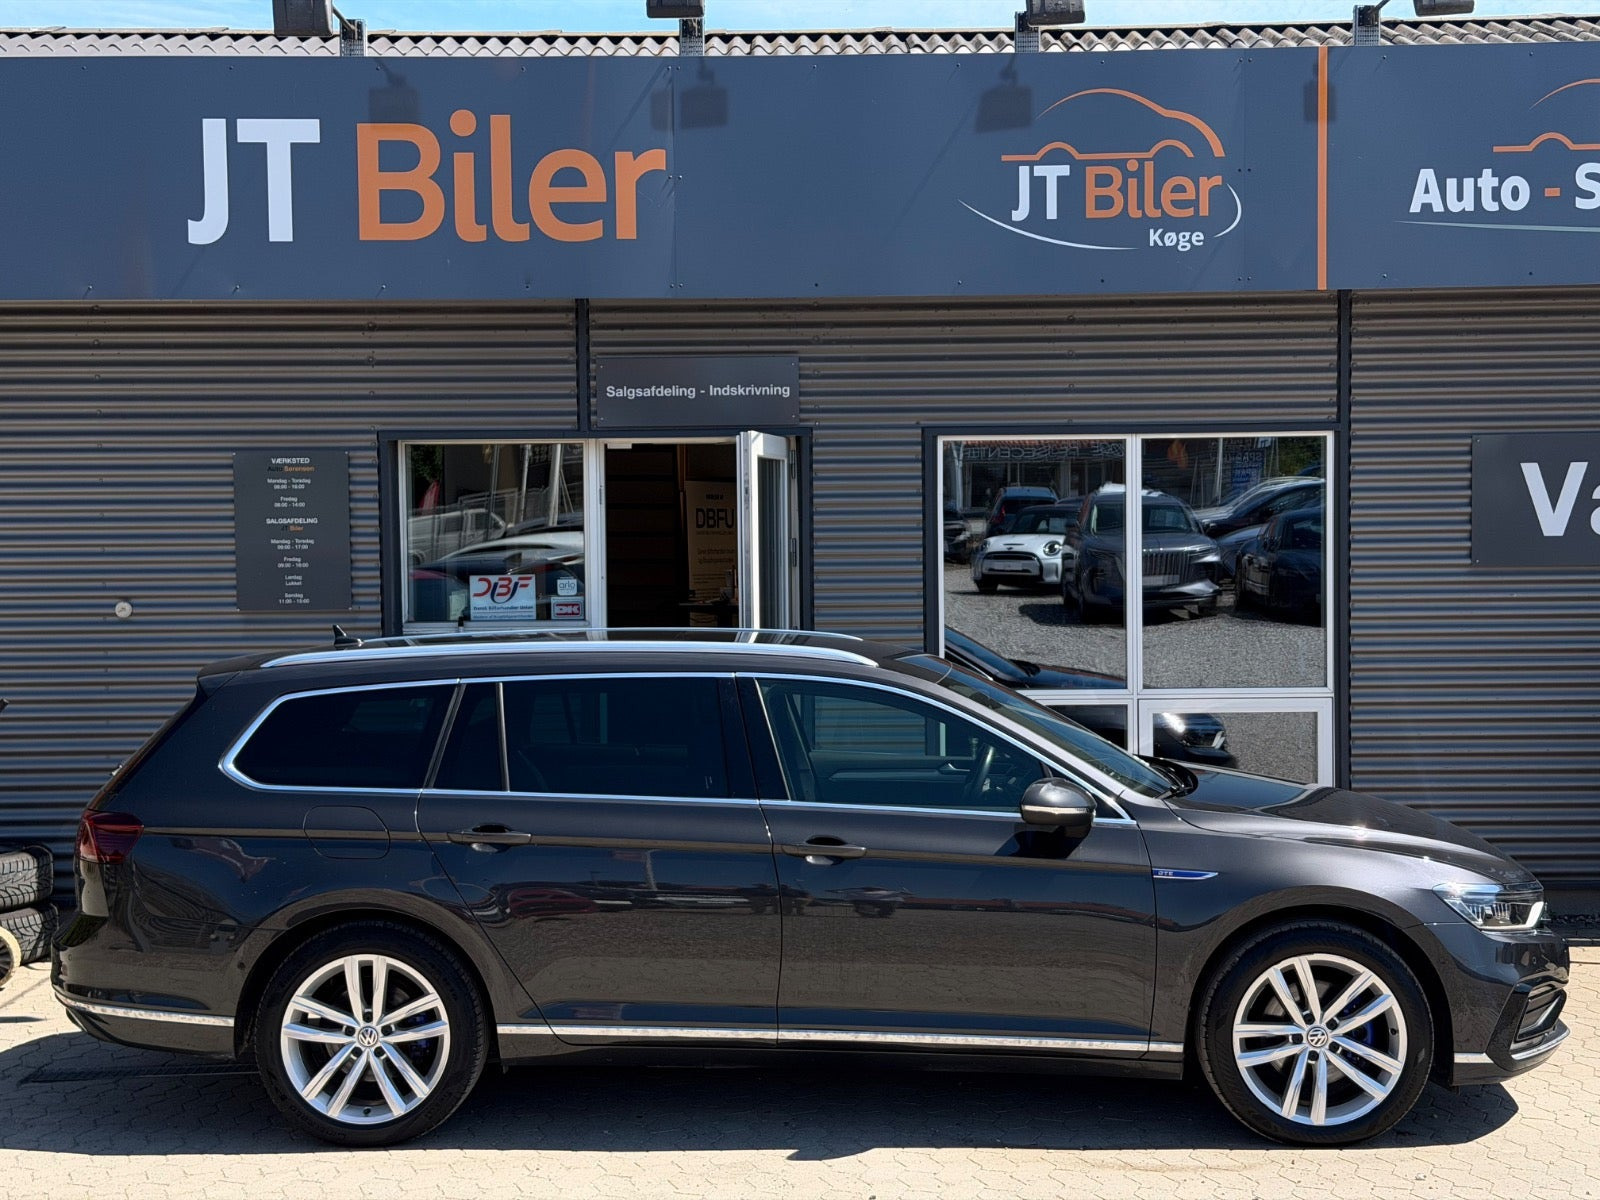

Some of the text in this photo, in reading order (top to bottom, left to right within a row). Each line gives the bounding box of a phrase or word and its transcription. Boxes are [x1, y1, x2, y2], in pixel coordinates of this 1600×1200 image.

[187, 109, 666, 245] JT Biler
[1011, 158, 1222, 222] JT Biler
[1409, 168, 1531, 213] Auto
[1544, 187, 1561, 197] -
[1149, 228, 1205, 252] Køge
[606, 385, 696, 400] Salgsafdeling
[709, 384, 791, 398] Indskrivning
[695, 508, 735, 529] DBFU
[1520, 461, 1600, 537] V
